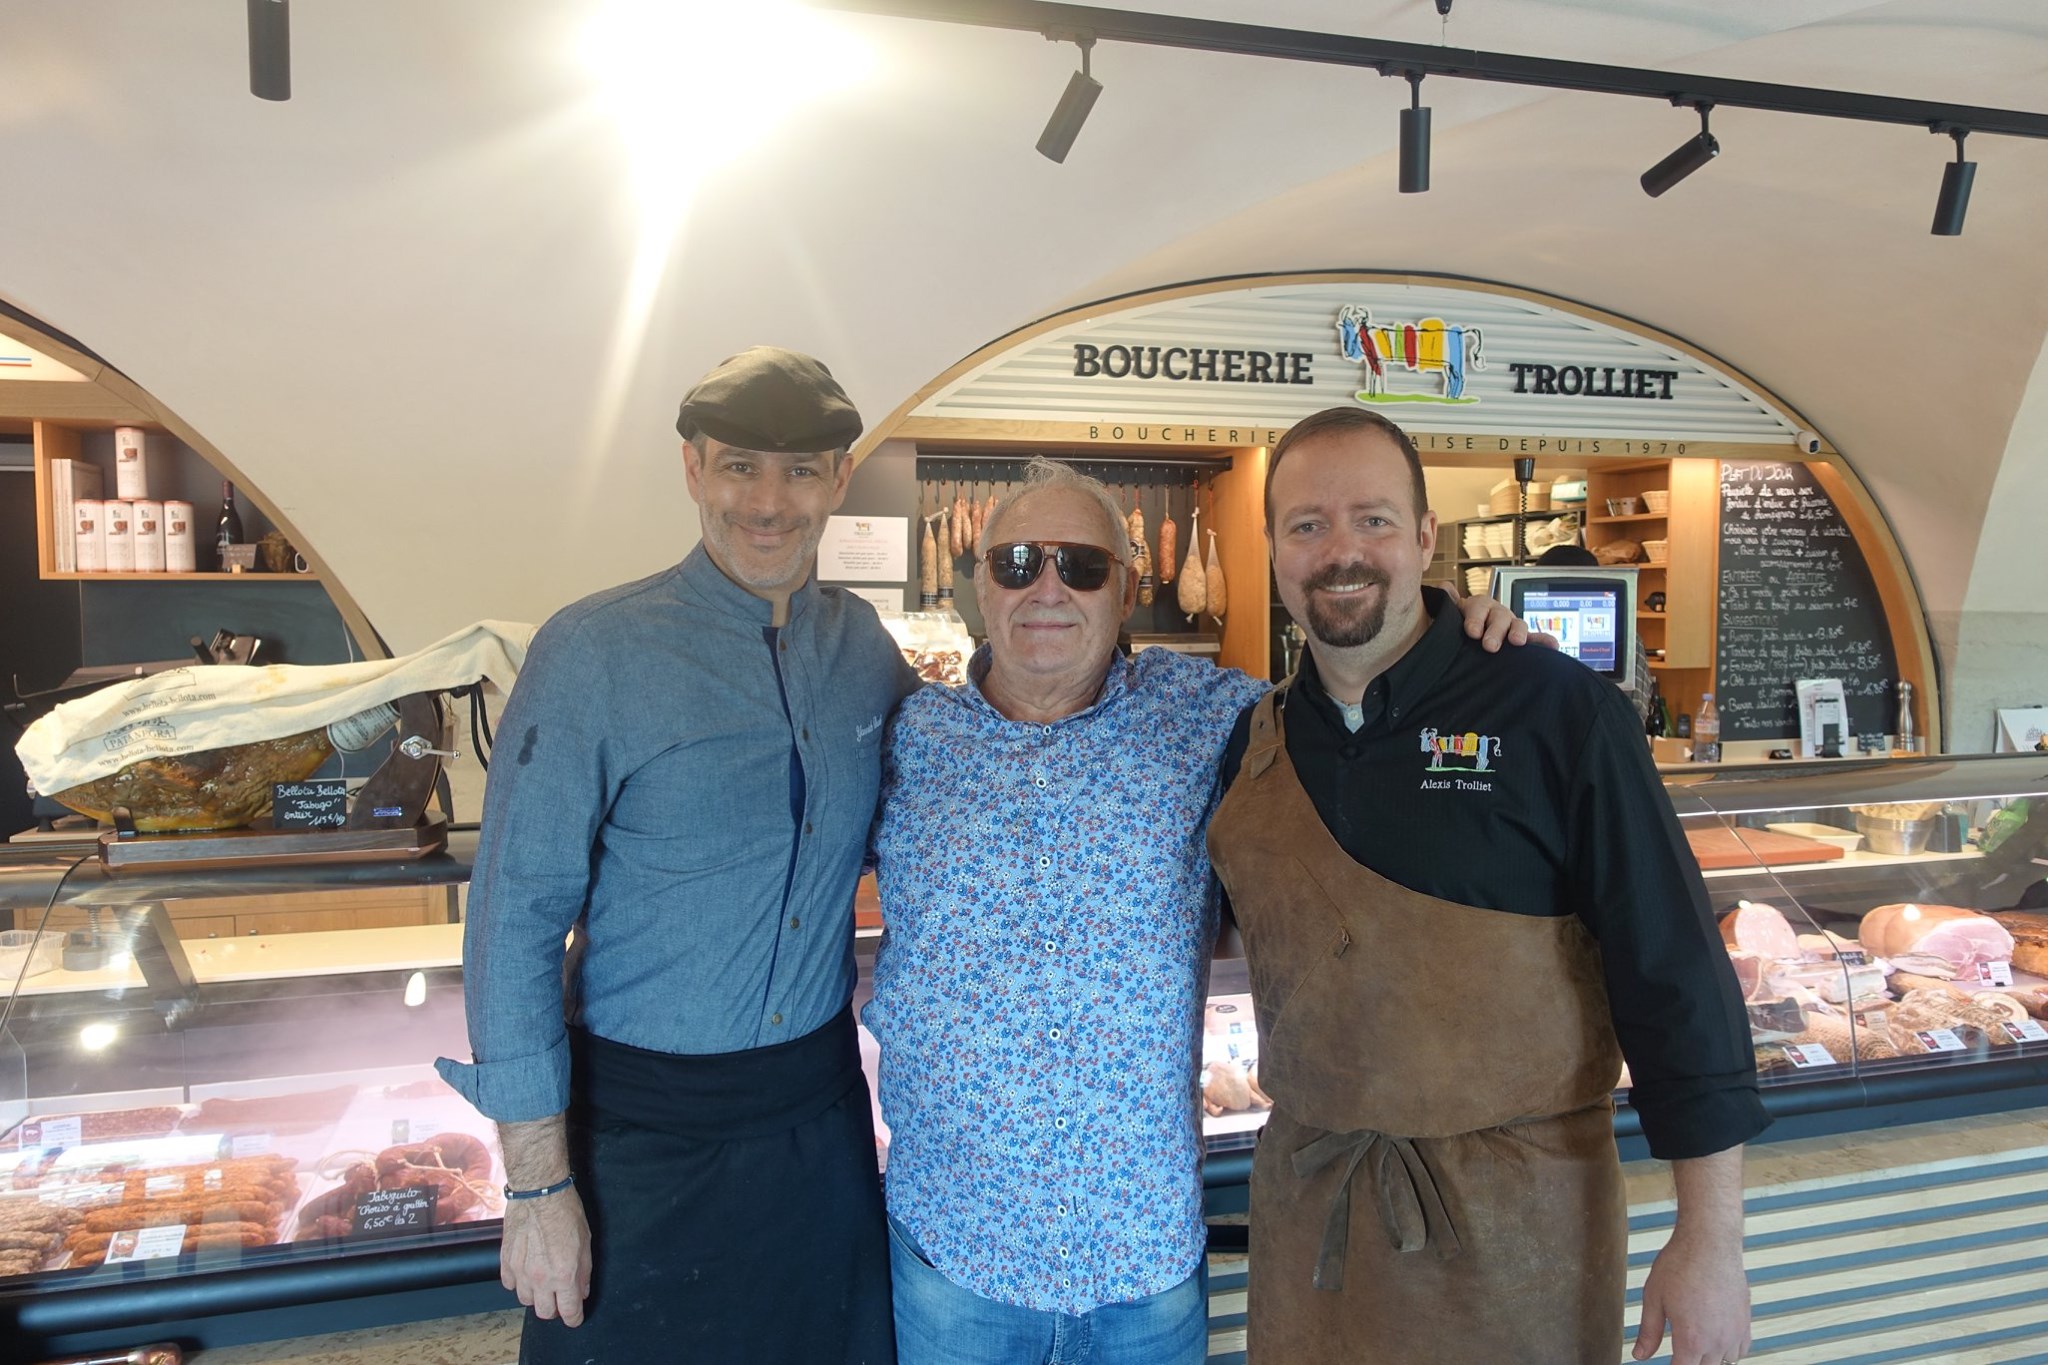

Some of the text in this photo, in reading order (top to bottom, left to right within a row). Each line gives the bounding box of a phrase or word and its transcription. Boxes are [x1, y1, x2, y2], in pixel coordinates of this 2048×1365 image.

[1074, 344, 1679, 399] BOUCHERIE TROLLIET
[1089, 426, 1277, 444] BOUCHERIE
[1500, 438, 1686, 455] DEPUIS 1970
[1420, 779, 1492, 791] Alexis Trolliet
